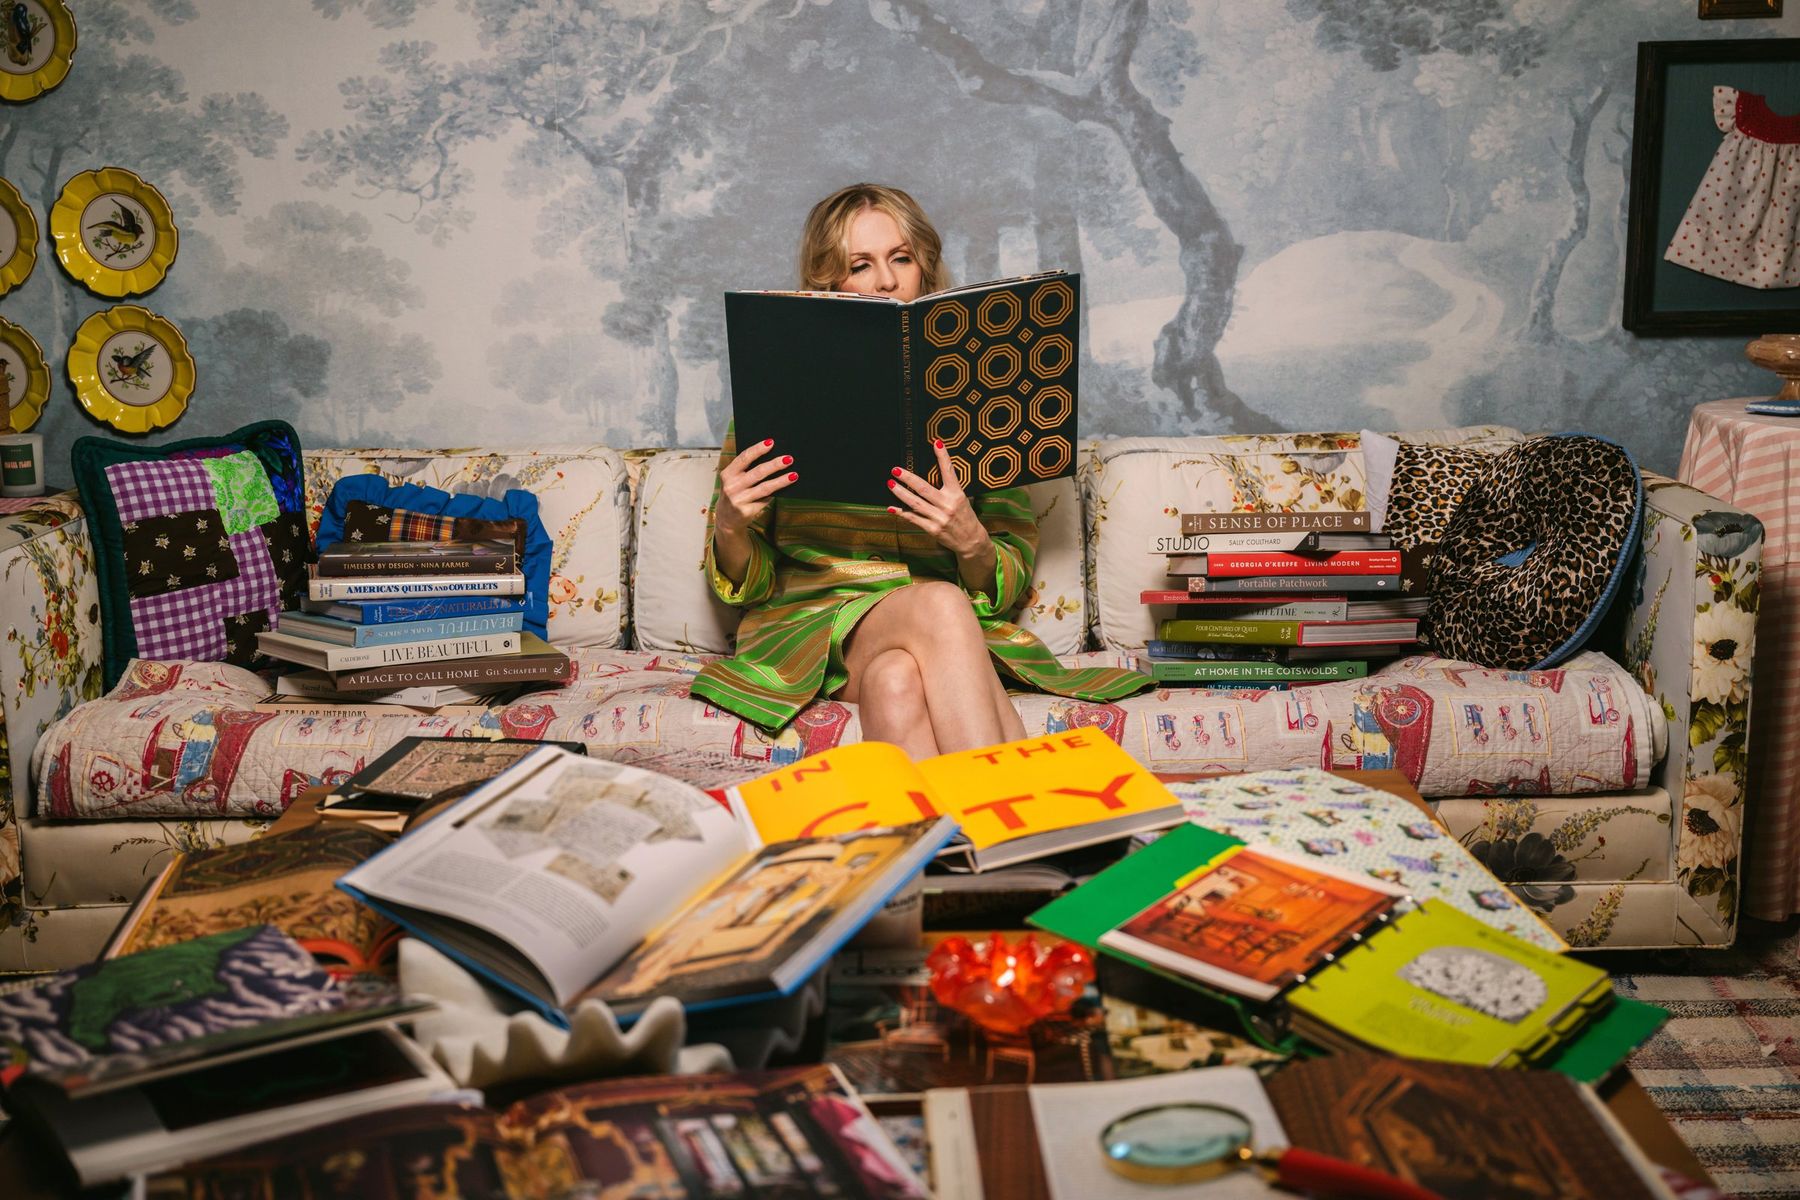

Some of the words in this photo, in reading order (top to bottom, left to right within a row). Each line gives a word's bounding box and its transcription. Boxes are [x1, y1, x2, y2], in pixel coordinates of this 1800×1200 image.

[1208, 516, 1262, 530] SENSE
[1266, 516, 1288, 529] OF
[1291, 515, 1343, 528] PLACE
[1156, 536, 1210, 551] STUDIO
[1228, 538, 1245, 546] SALLY
[343, 562, 376, 570] TIMELESS
[377, 562, 387, 570] BY
[388, 561, 415, 569] DESIGN
[420, 561, 440, 569] NINA
[1304, 560, 1329, 568] LIVING
[346, 584, 400, 594] AMERICA'S
[401, 583, 433, 594] QUILTS
[448, 582, 499, 592] COVERLETS
[1238, 578, 1277, 589] Portable
[1279, 578, 1328, 588] Patchwork
[438, 617, 514, 635] BEAUTIFUL
[1195, 624, 1208, 632] FOUR
[382, 646, 415, 663] LIVE
[417, 639, 493, 659] BEAUTIFUL
[348, 676, 357, 685] A
[359, 674, 394, 684] PLACE
[396, 673, 414, 682] TO
[415, 671, 445, 681] CALL
[446, 669, 480, 680] HOME
[1194, 668, 1207, 676] AT
[1209, 667, 1239, 676] HOME
[1241, 668, 1252, 676] IN
[1254, 667, 1274, 676] THE
[1276, 666, 1339, 676] COTSWOLDS
[770, 759, 832, 792] IN
[972, 734, 1093, 765] THE
